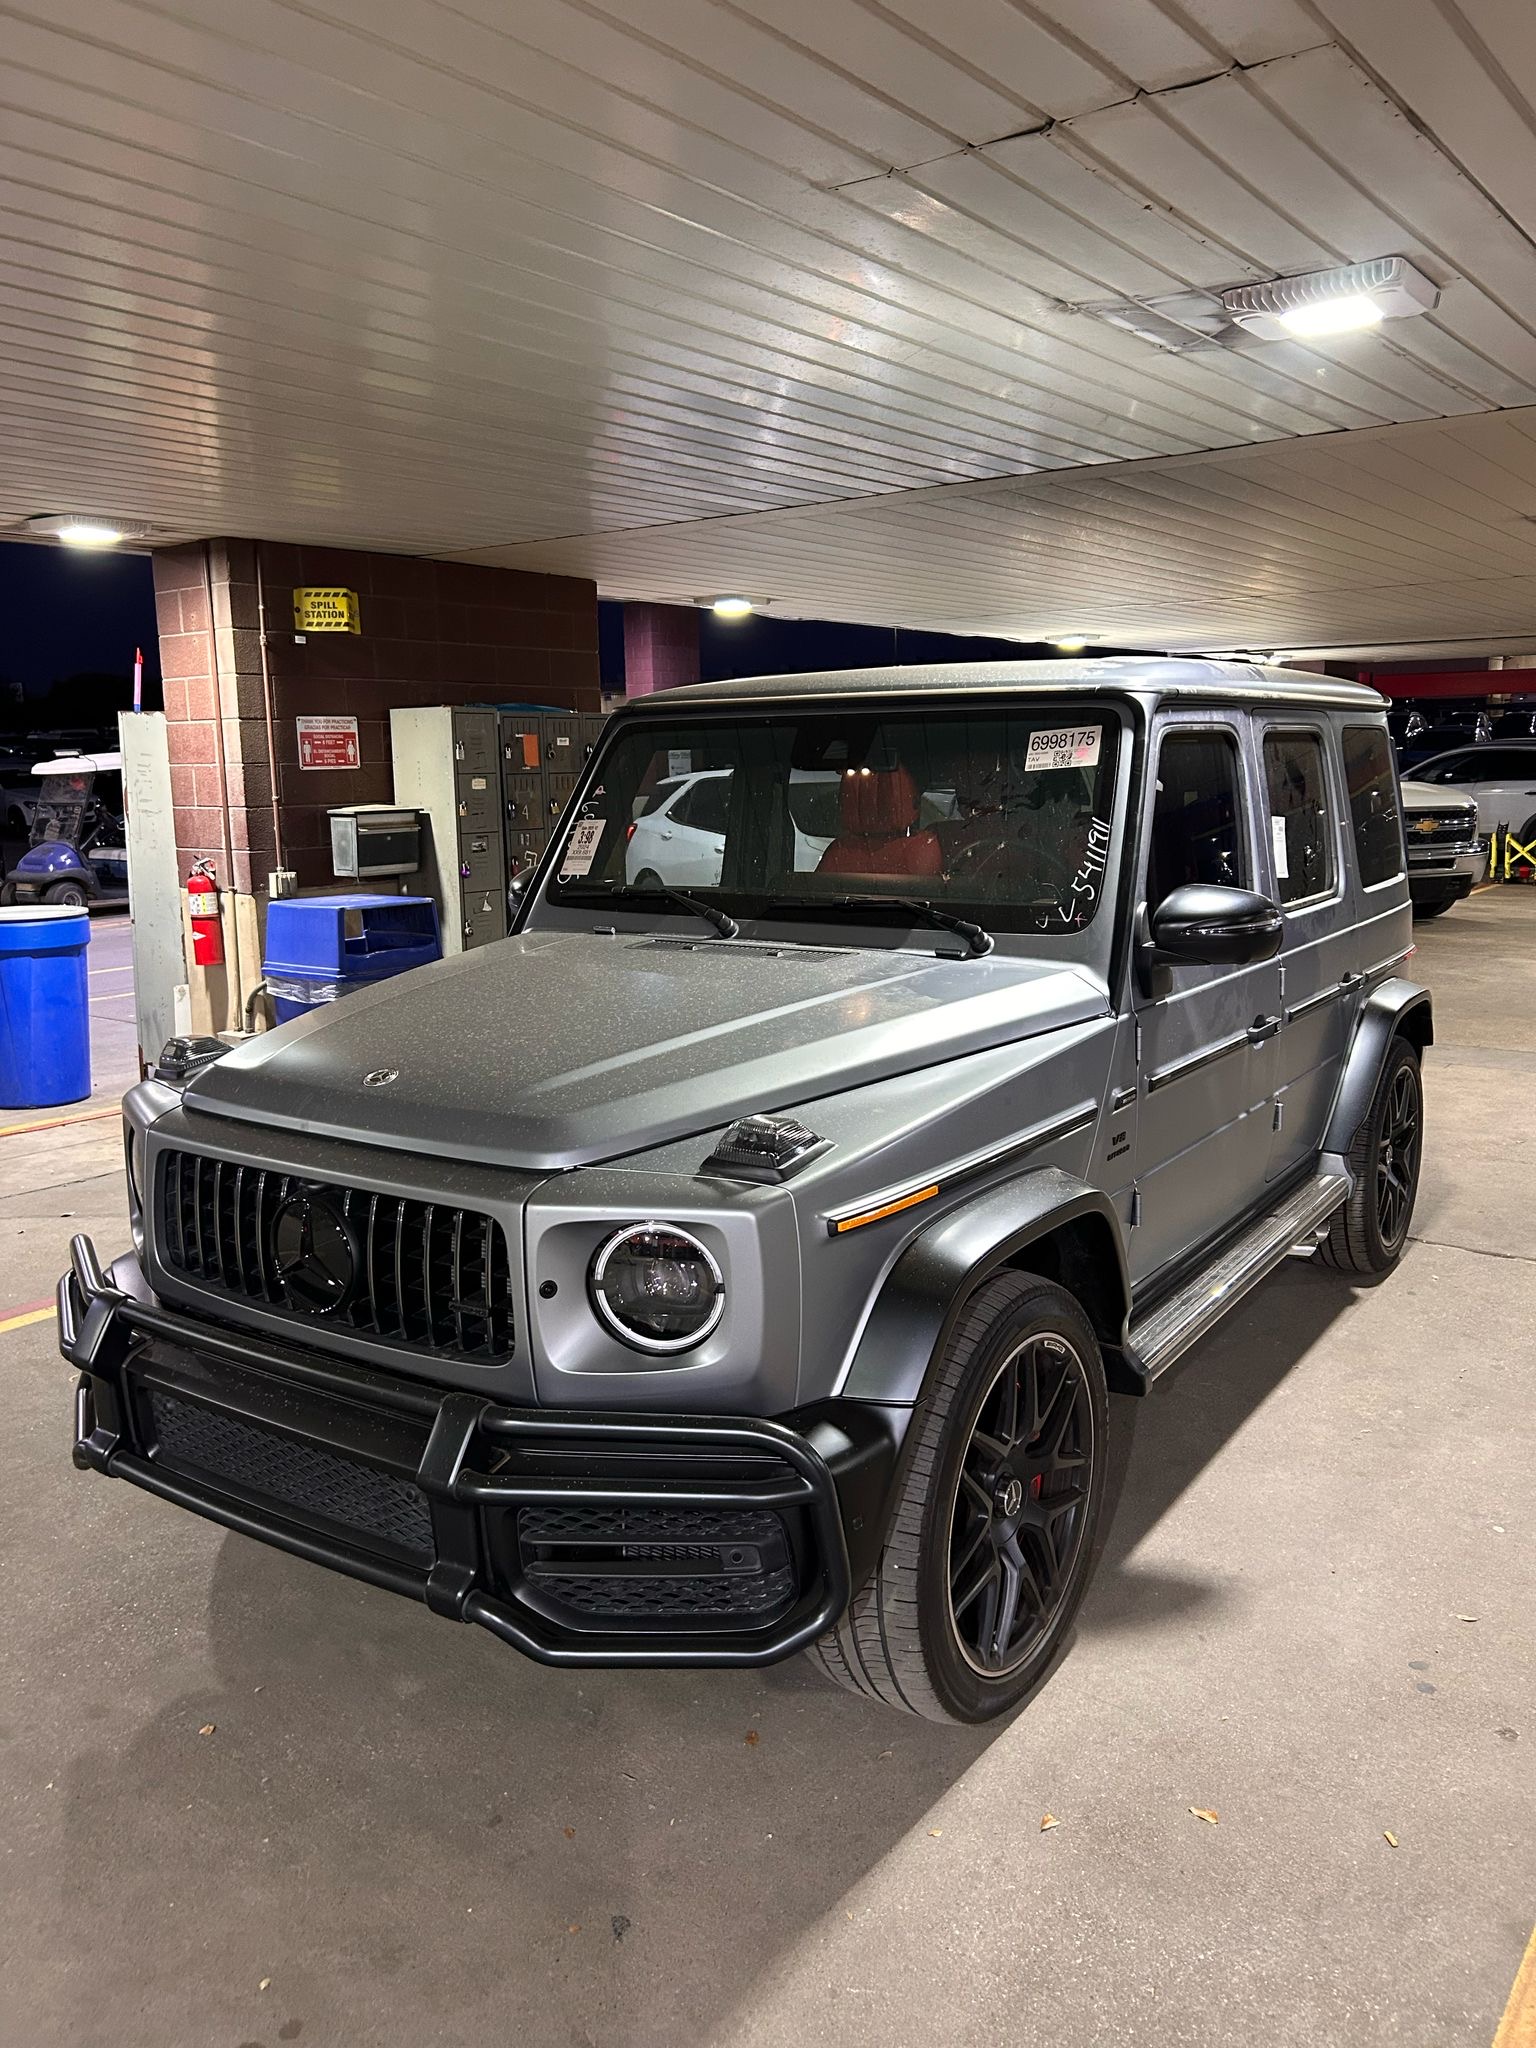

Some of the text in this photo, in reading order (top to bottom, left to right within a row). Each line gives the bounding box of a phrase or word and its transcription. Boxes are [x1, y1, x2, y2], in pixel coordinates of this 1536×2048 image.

[310, 601, 338, 610] SPILL
[304, 610, 345, 619] STATION
[1031, 730, 1096, 752] 6998175
